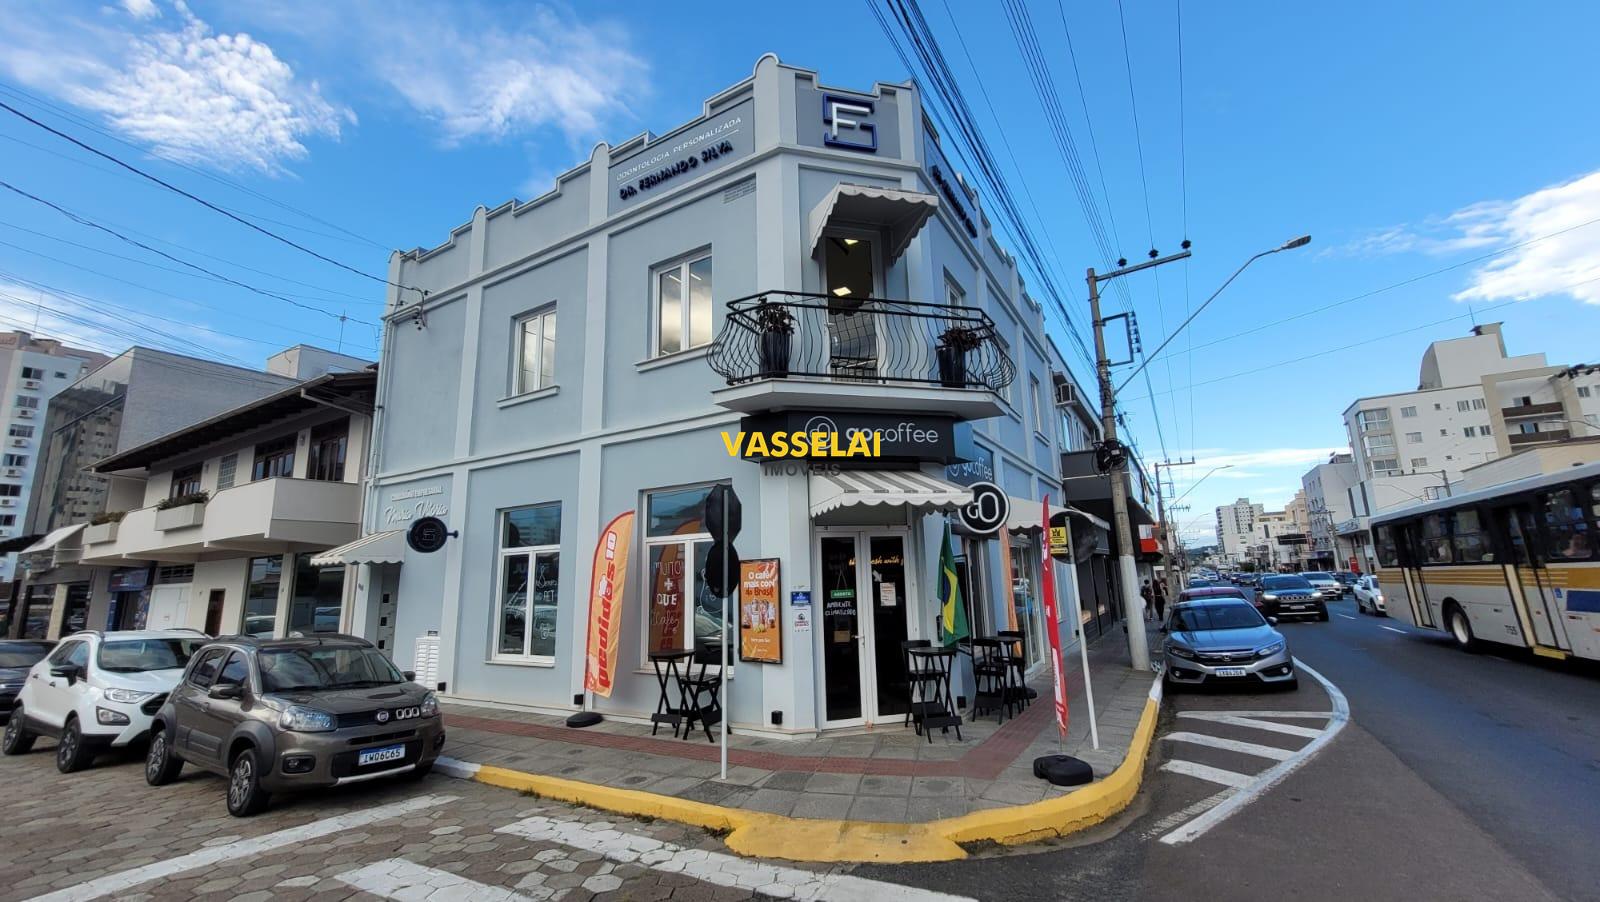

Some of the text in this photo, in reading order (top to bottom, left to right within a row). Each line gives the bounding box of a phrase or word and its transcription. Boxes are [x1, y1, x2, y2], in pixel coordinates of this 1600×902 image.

[616, 116, 742, 181] ODONTOLOGIA PERSONALIZADA
[639, 156, 699, 191] FERNANDO
[700, 140, 734, 163] SILVA
[656, 593, 677, 606] QUE
